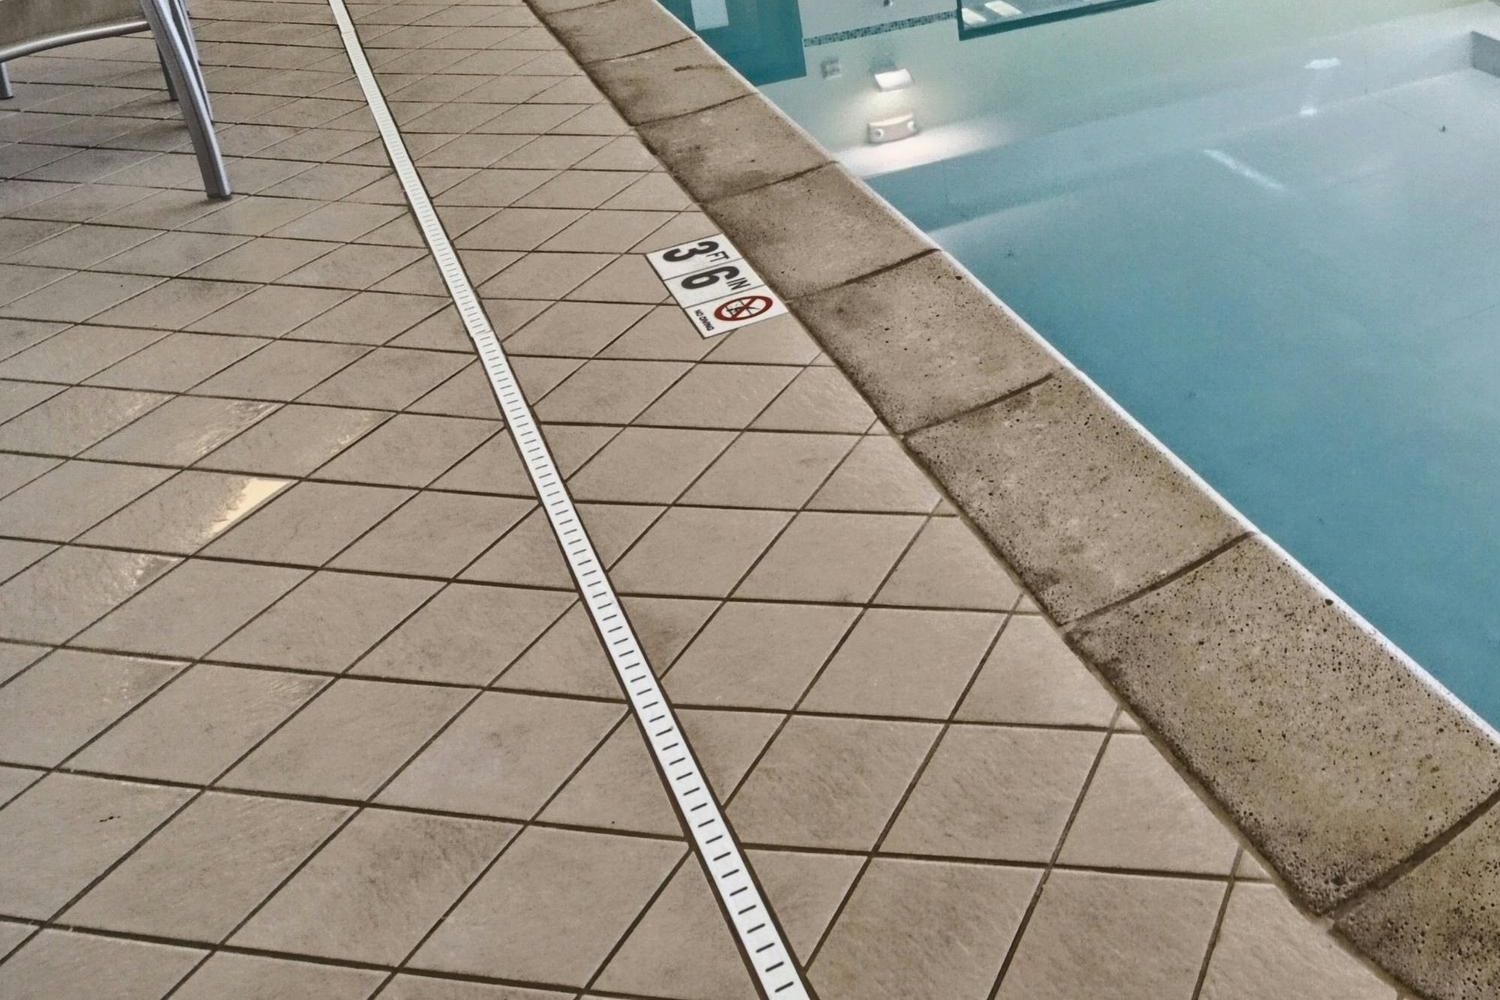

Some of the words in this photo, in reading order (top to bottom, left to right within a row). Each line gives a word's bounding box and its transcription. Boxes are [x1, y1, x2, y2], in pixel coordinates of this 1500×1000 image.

[662, 240, 719, 262] 3
[706, 250, 730, 262] FT
[681, 265, 740, 290] 6
[727, 277, 750, 290] IN
